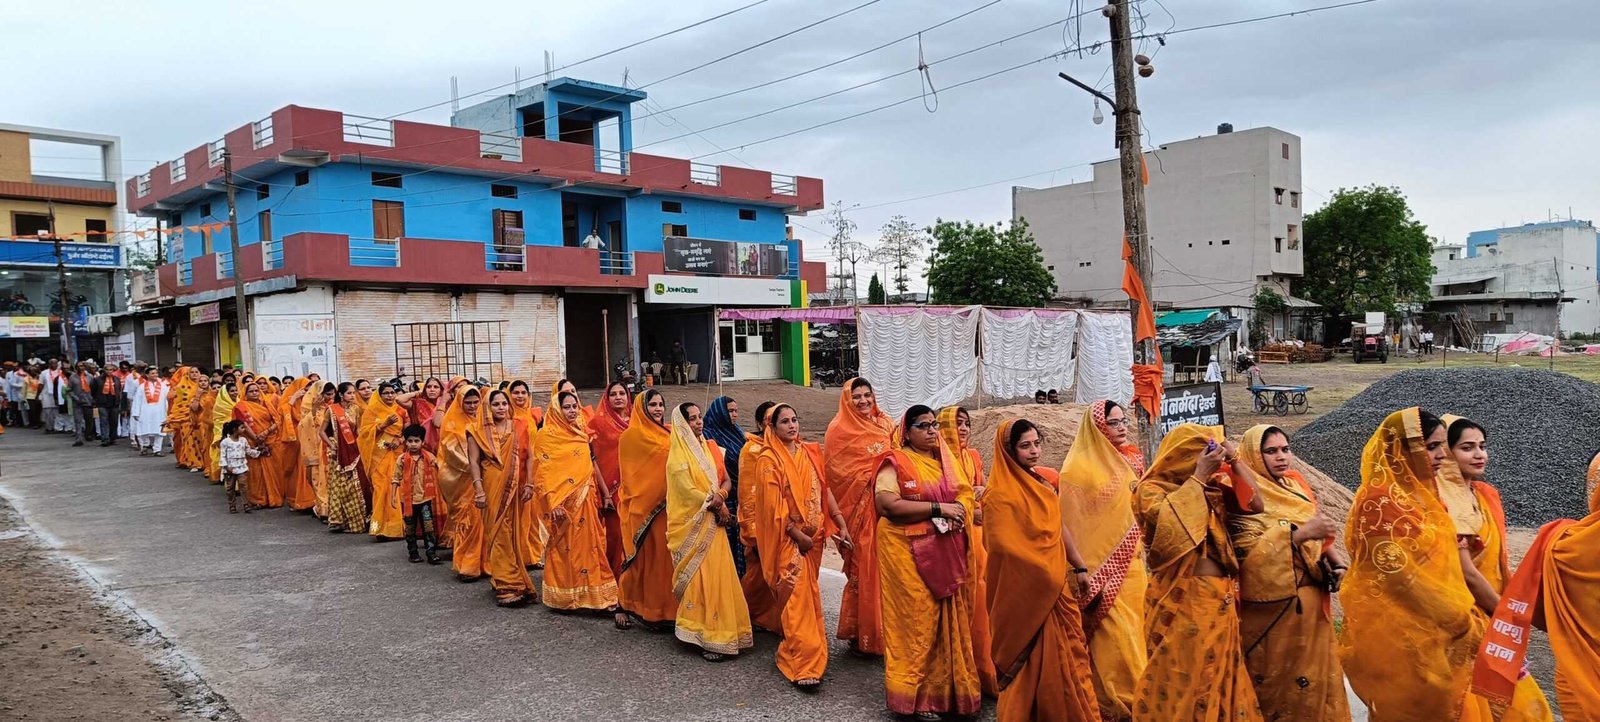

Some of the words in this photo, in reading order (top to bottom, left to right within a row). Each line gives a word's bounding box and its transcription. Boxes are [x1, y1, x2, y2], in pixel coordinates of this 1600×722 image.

[681, 286, 698, 294] DEERE
[1168, 390, 1199, 415] नर्मदा
[1492, 618, 1524, 645] परशु
[1485, 641, 1516, 663] राम
